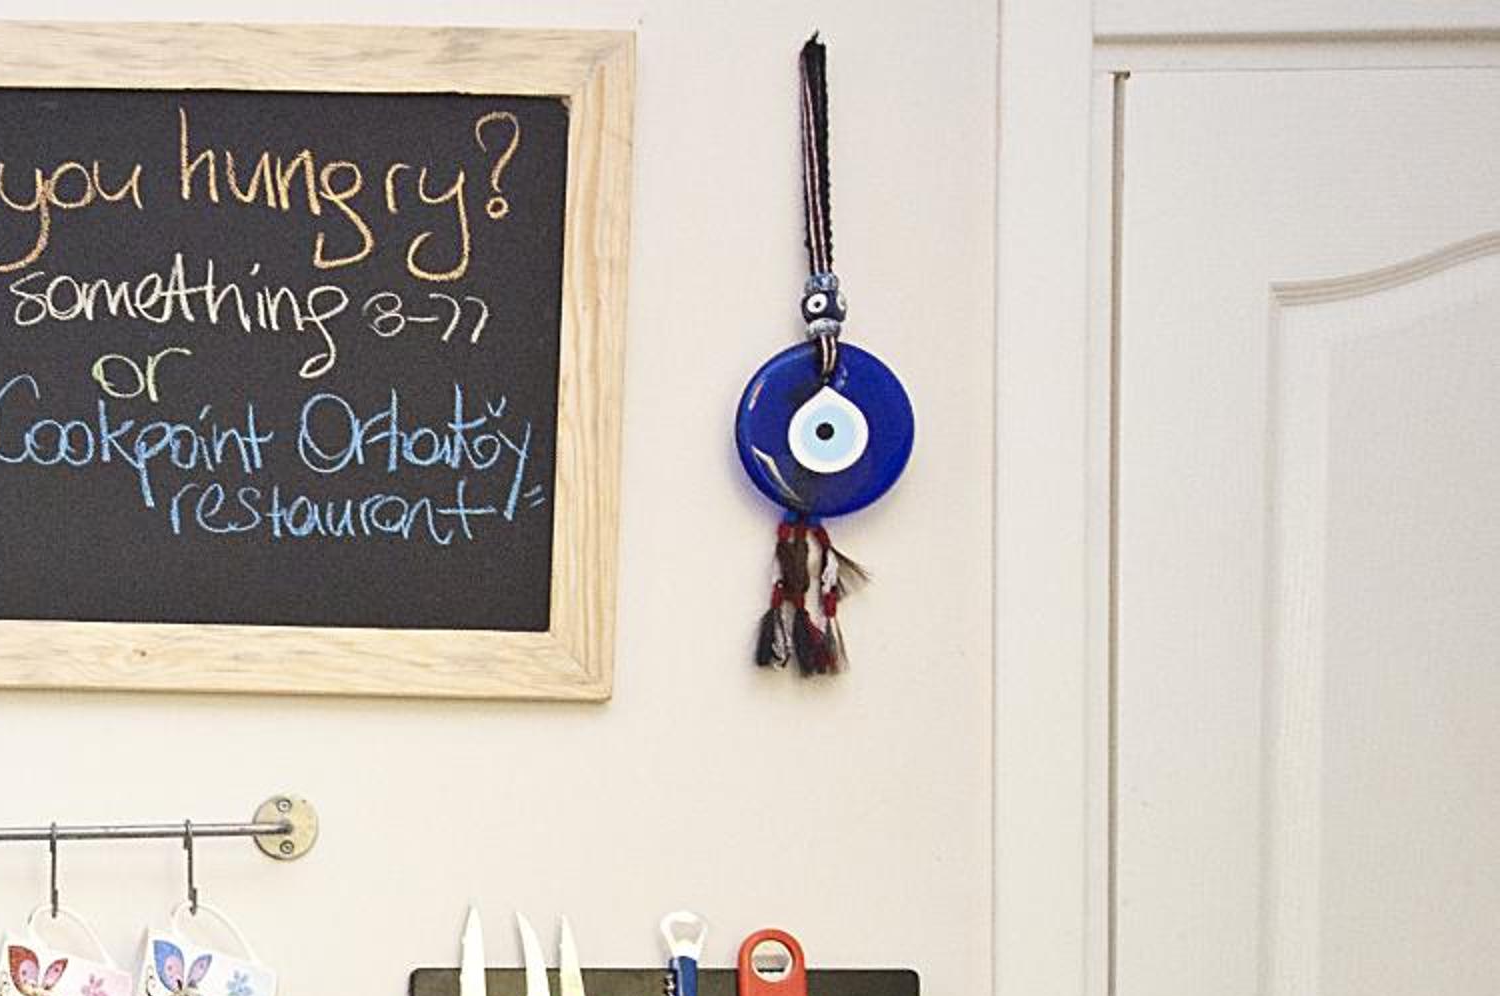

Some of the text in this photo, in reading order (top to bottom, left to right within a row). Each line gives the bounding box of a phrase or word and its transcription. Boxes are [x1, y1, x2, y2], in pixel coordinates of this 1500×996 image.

[179, 106, 522, 281] hungry?
[8, 251, 350, 378] something
[91, 345, 193, 402] or
